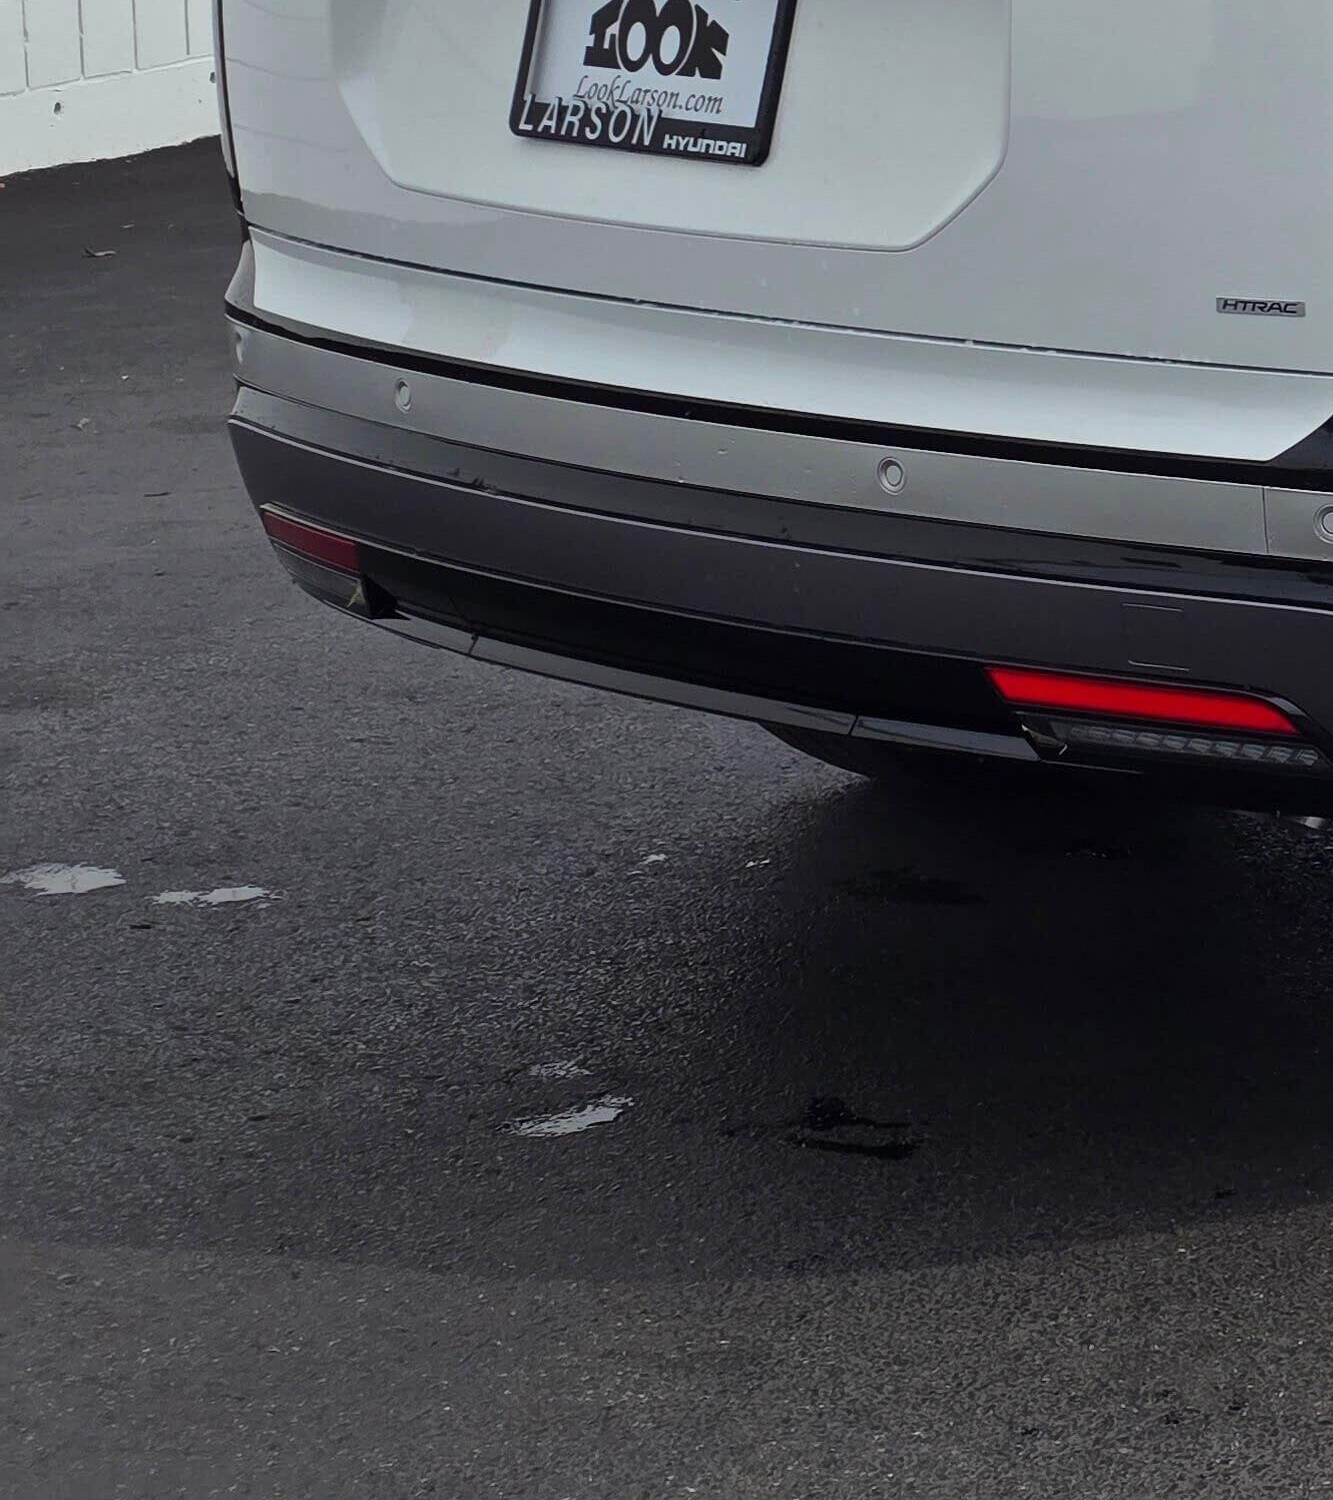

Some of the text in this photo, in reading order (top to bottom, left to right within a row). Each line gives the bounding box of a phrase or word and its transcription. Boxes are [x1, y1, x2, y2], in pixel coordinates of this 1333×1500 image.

[573, 75, 723, 115] LookLarson.com
[518, 96, 660, 147] LARSON
[663, 134, 748, 158] HYUNDAI
[1222, 300, 1299, 314] HTRAC
